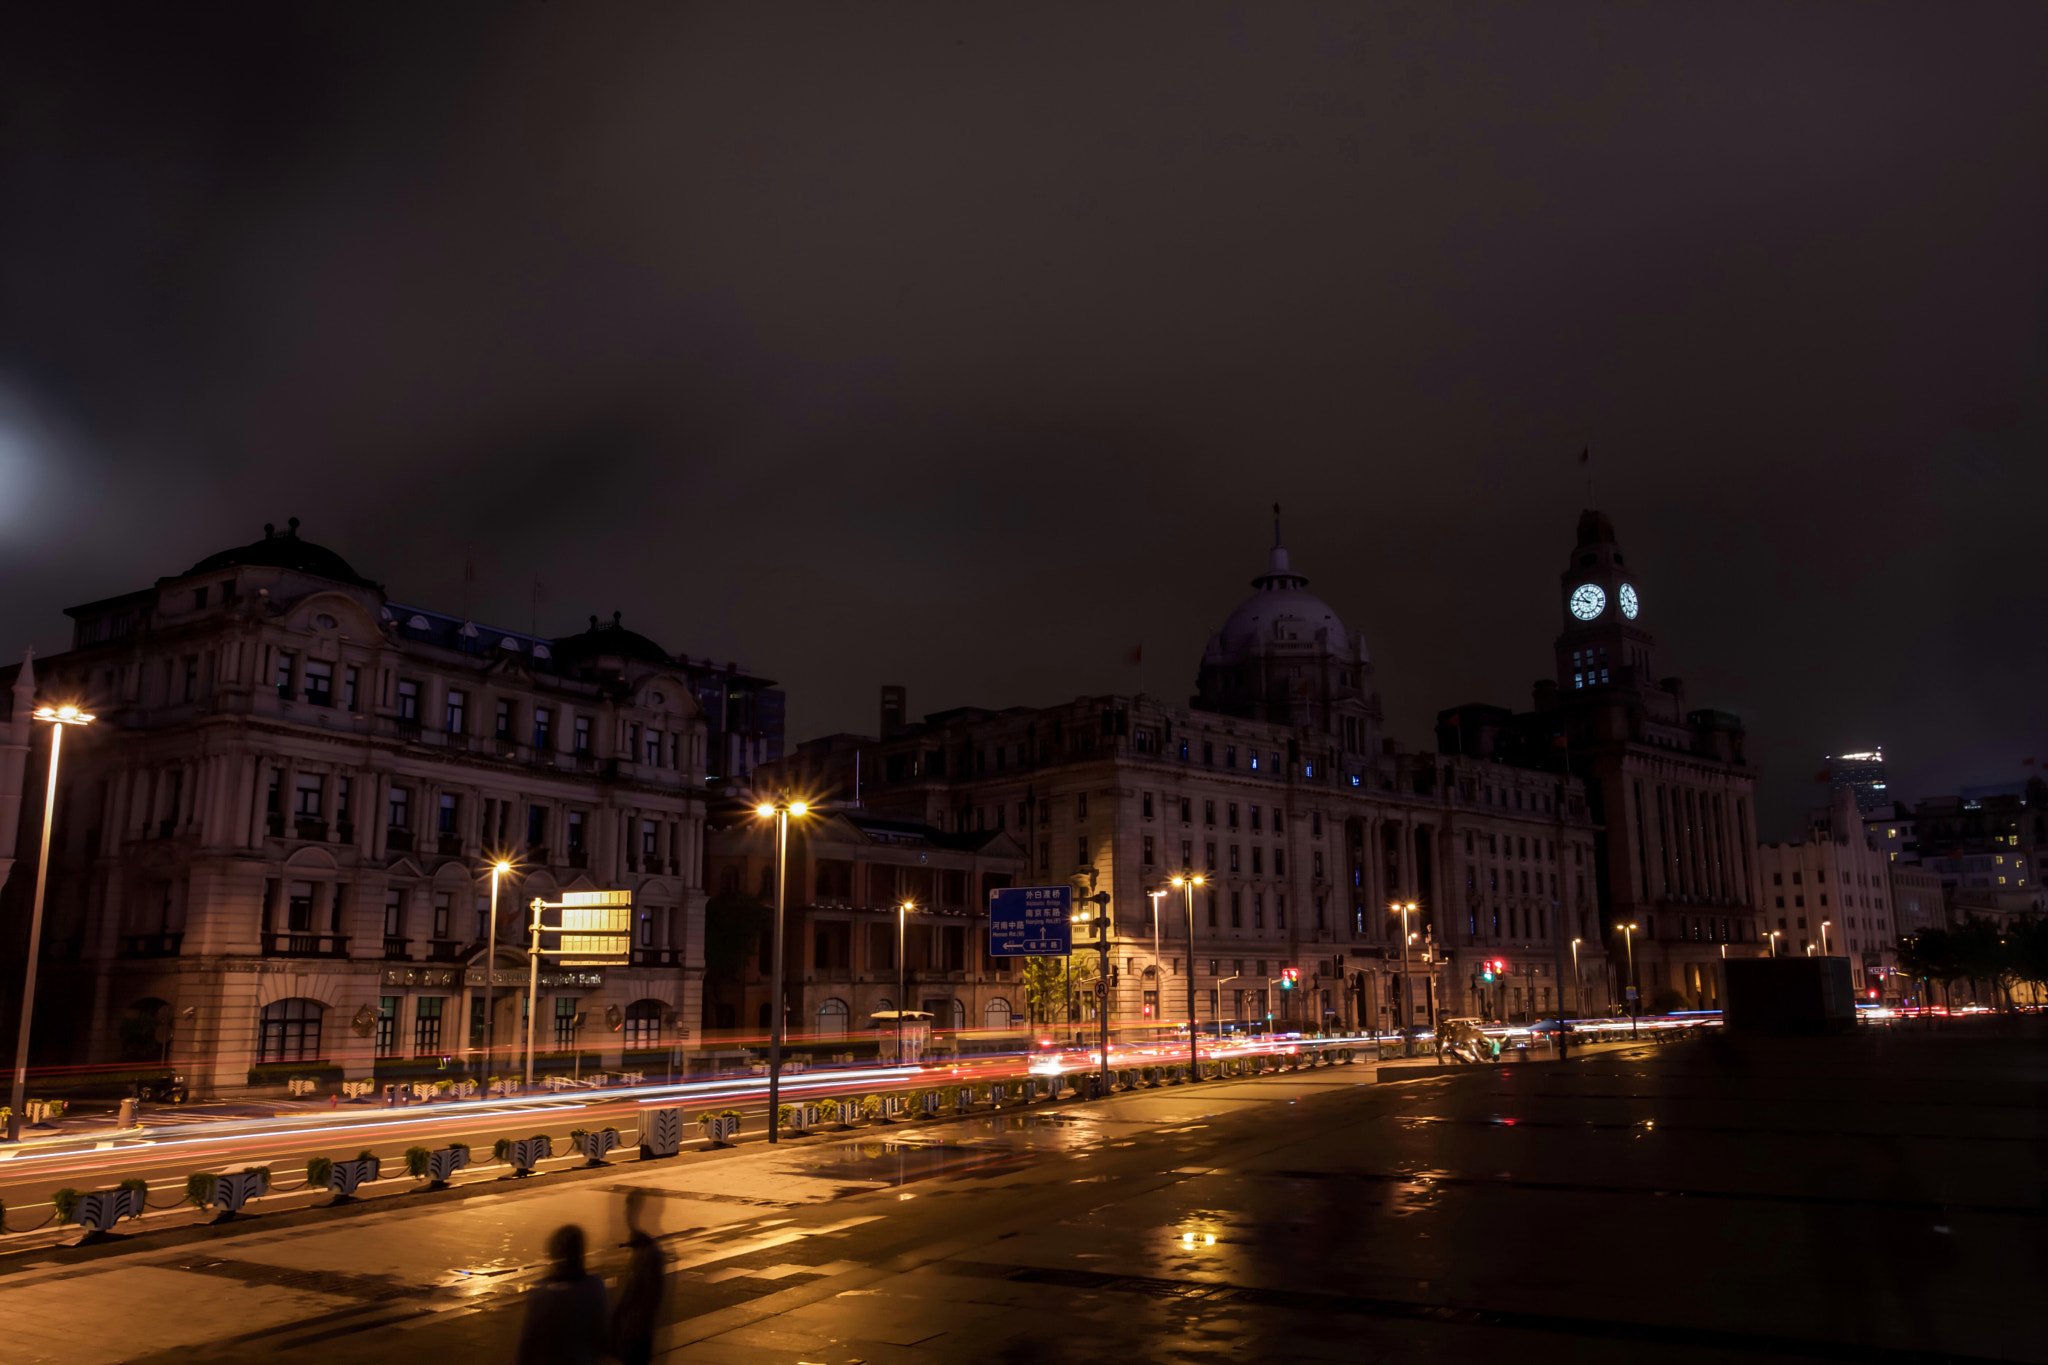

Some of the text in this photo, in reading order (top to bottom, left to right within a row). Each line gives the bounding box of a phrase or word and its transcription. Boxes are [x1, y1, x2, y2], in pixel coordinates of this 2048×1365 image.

[1026, 890, 1061, 899] 外白渡桥
[1025, 908, 1061, 918] 南京东路
[992, 921, 1024, 930] 河南中路
[537, 973, 575, 986] Bangkok
[579, 973, 601, 984] Bank
